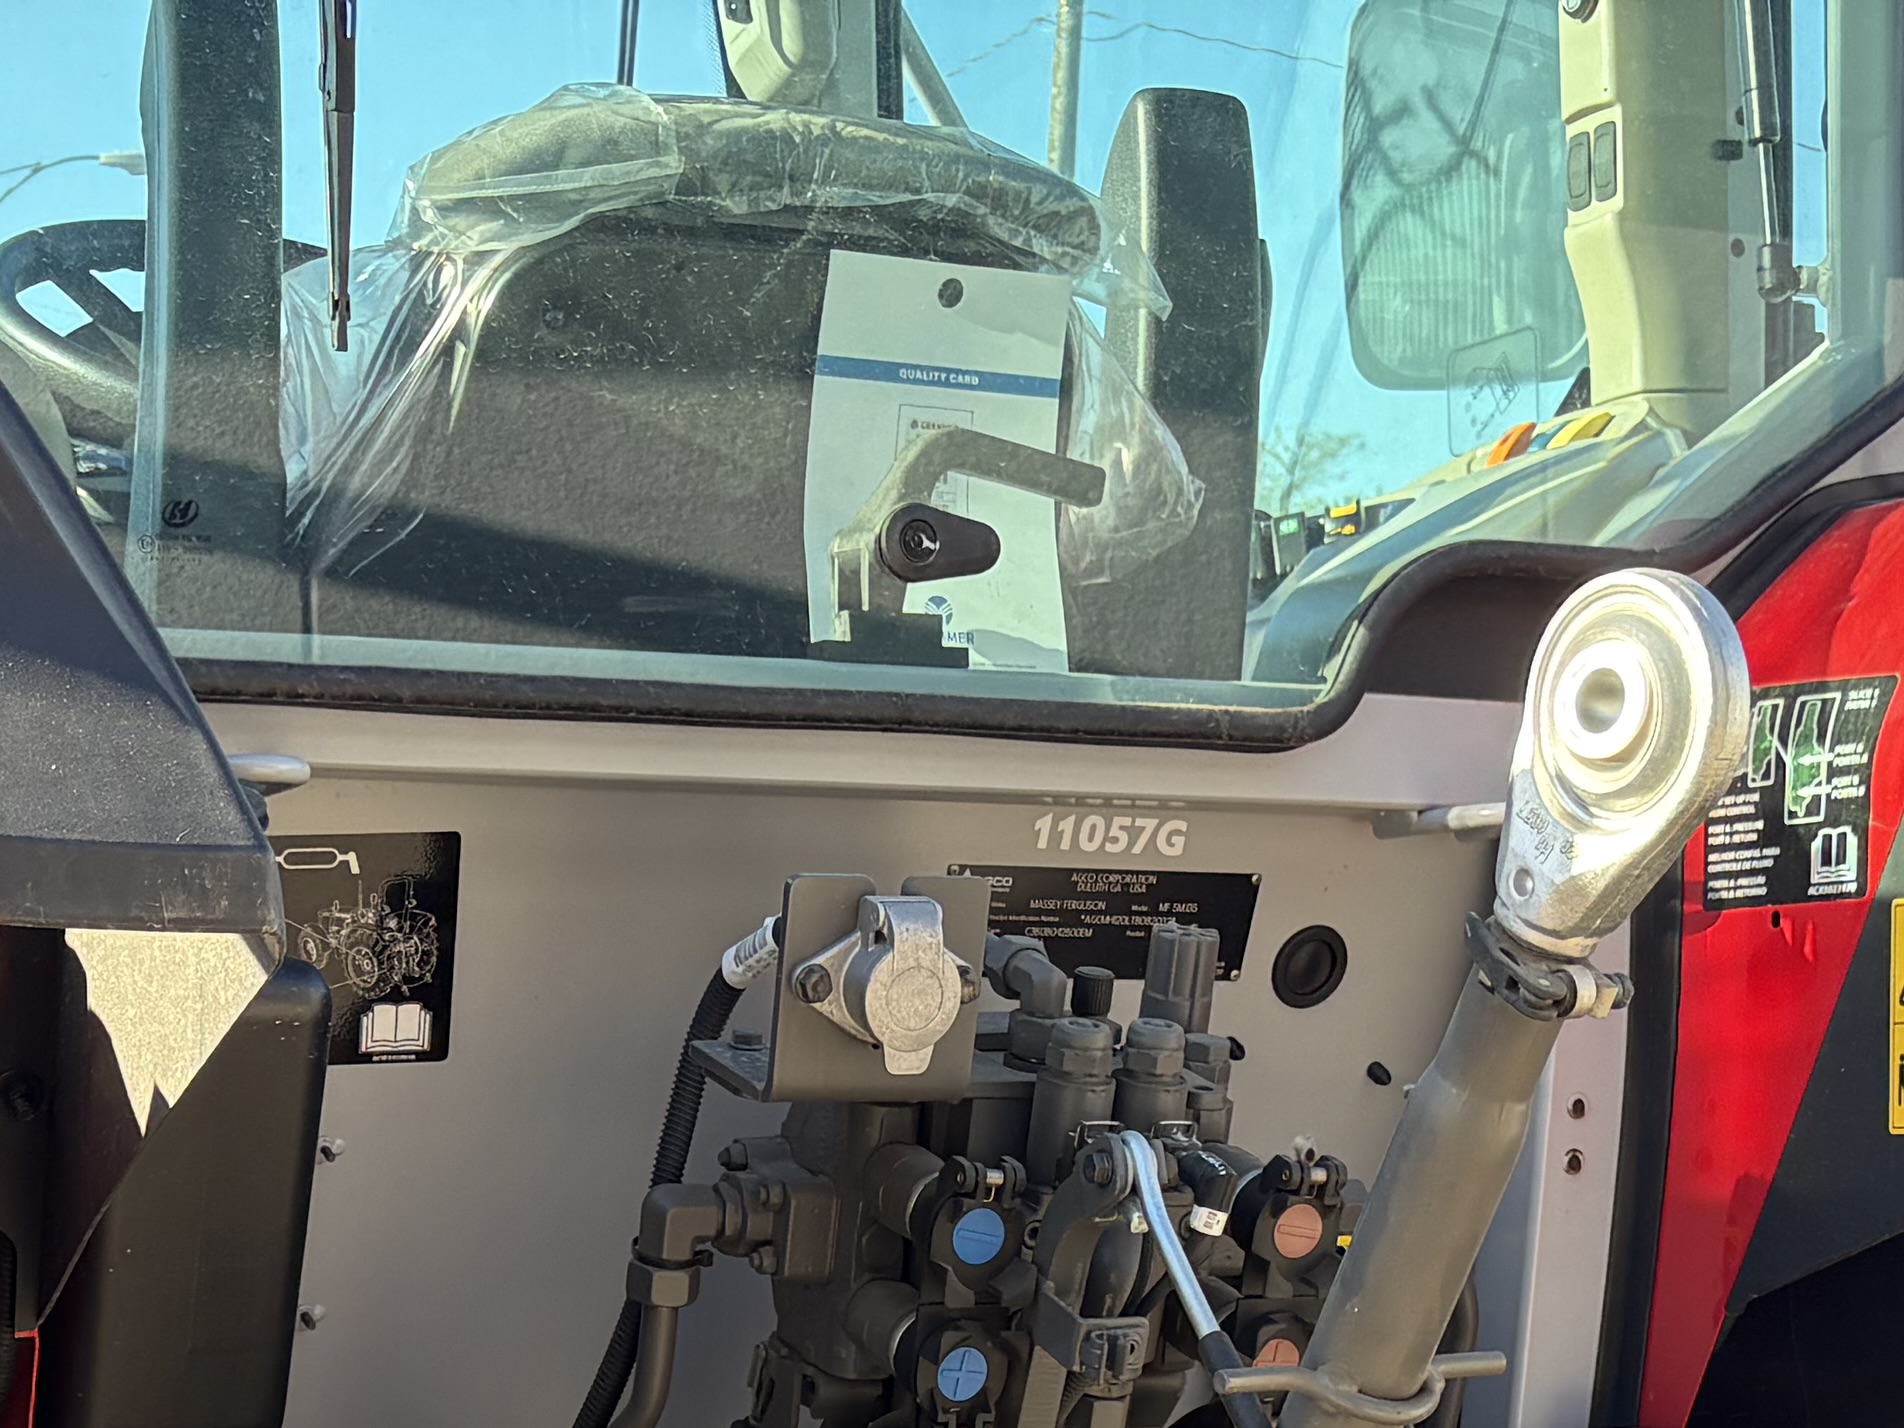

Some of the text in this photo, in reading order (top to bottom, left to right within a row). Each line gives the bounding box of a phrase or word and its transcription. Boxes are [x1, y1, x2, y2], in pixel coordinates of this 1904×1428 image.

[898, 367, 980, 387] QUALITY CARD
[1033, 811, 1188, 857] 11057G
[1029, 898, 1061, 911] MASSEY
[1063, 900, 1107, 911] FERGUSON
